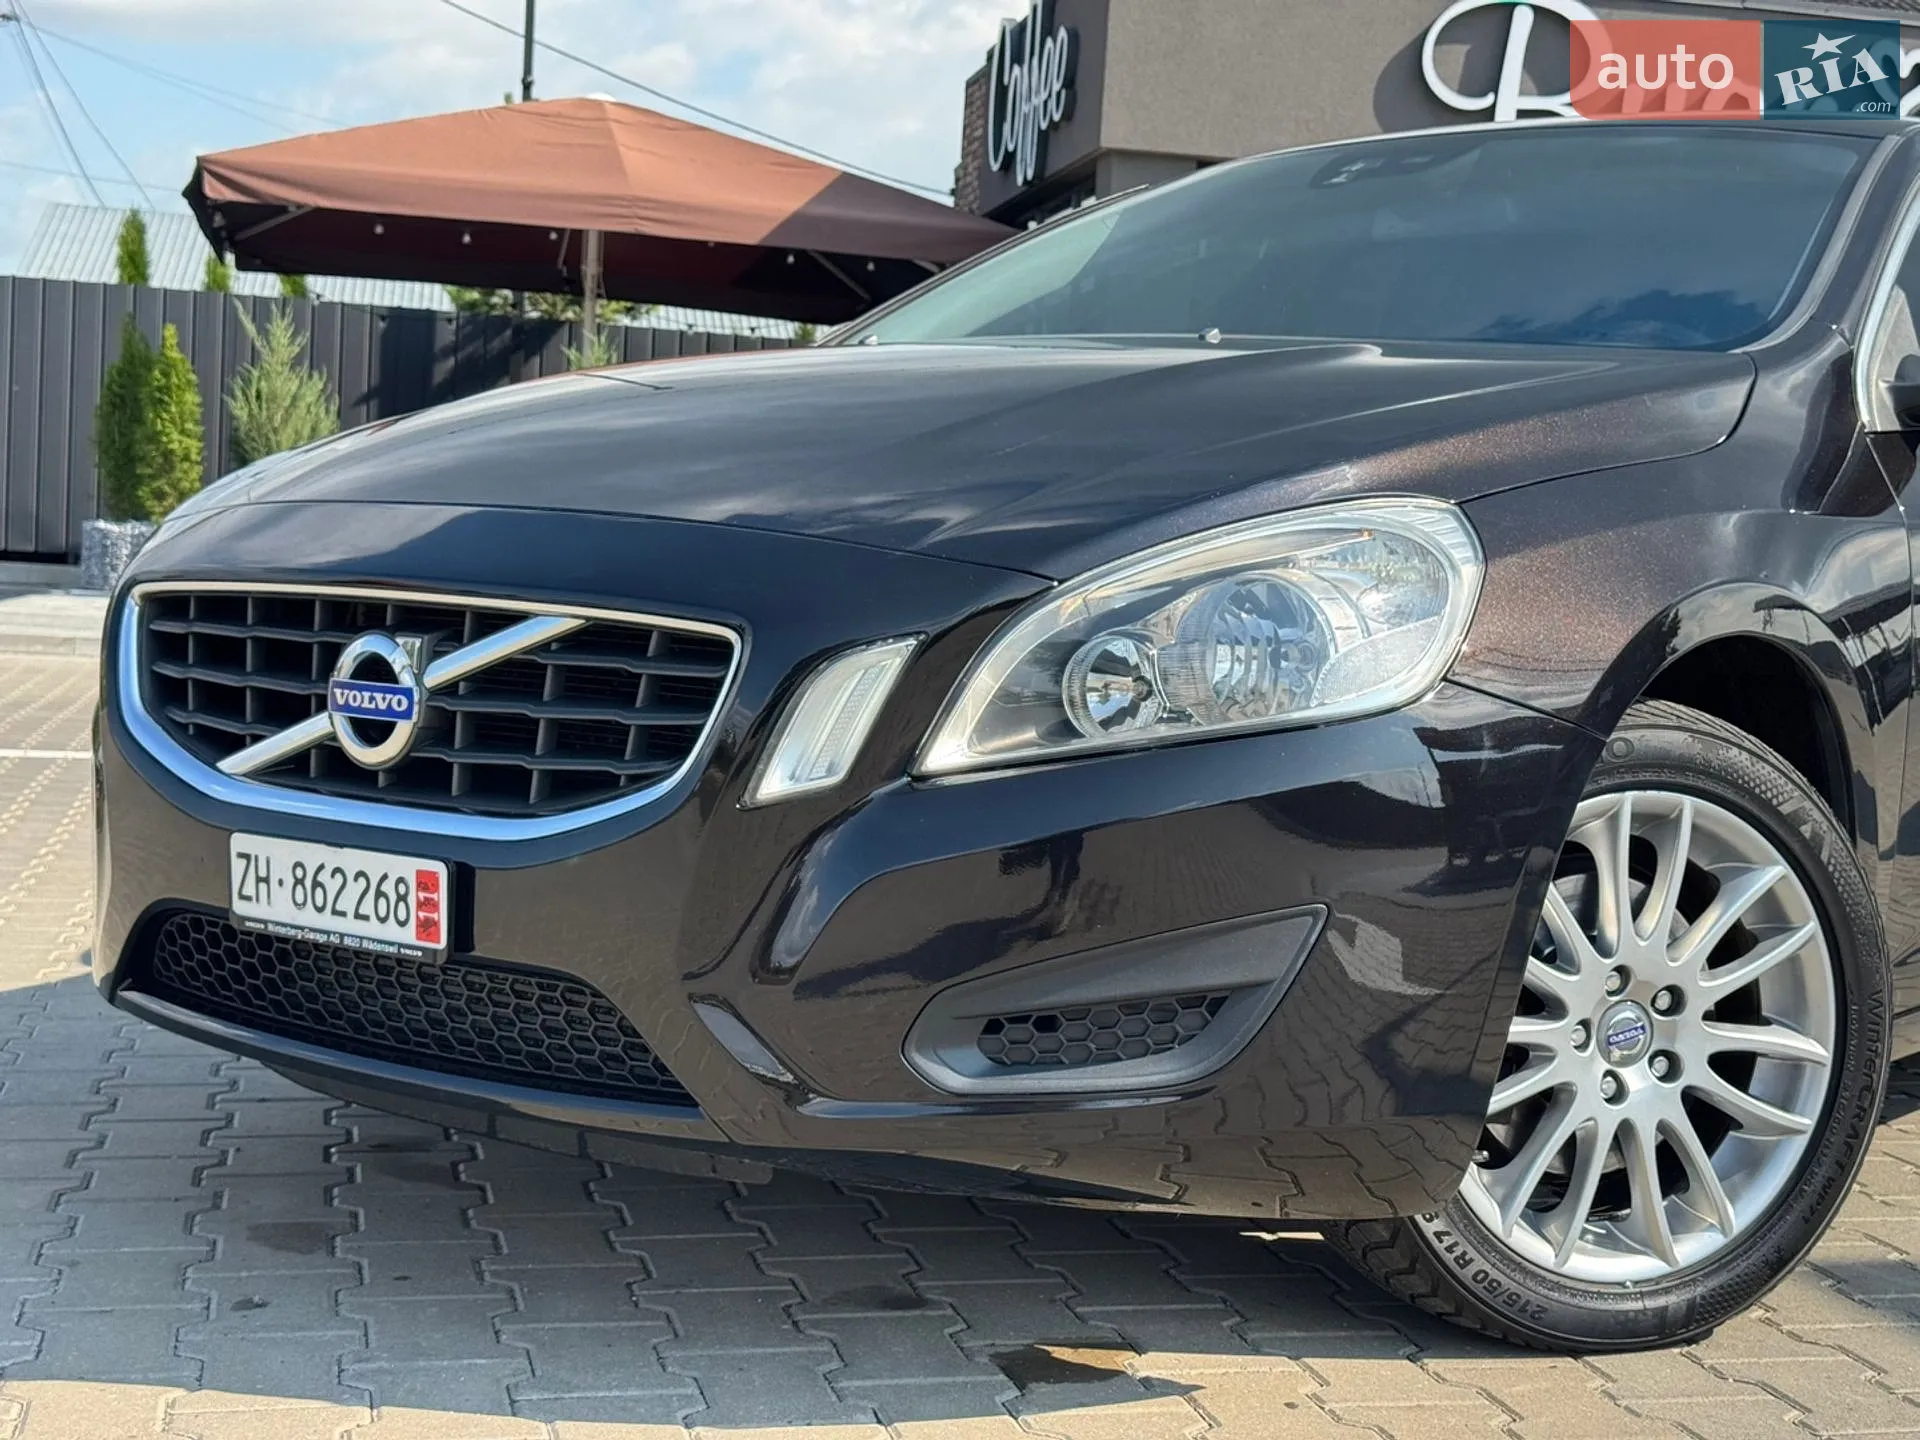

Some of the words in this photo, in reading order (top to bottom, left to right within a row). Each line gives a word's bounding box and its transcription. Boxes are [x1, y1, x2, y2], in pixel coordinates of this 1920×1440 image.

[988, 0, 1068, 186] Coffee
[333, 688, 409, 722] VOLVO
[1432, 1230, 1476, 1270] R17
[1471, 1268, 1550, 1321] 215/50
